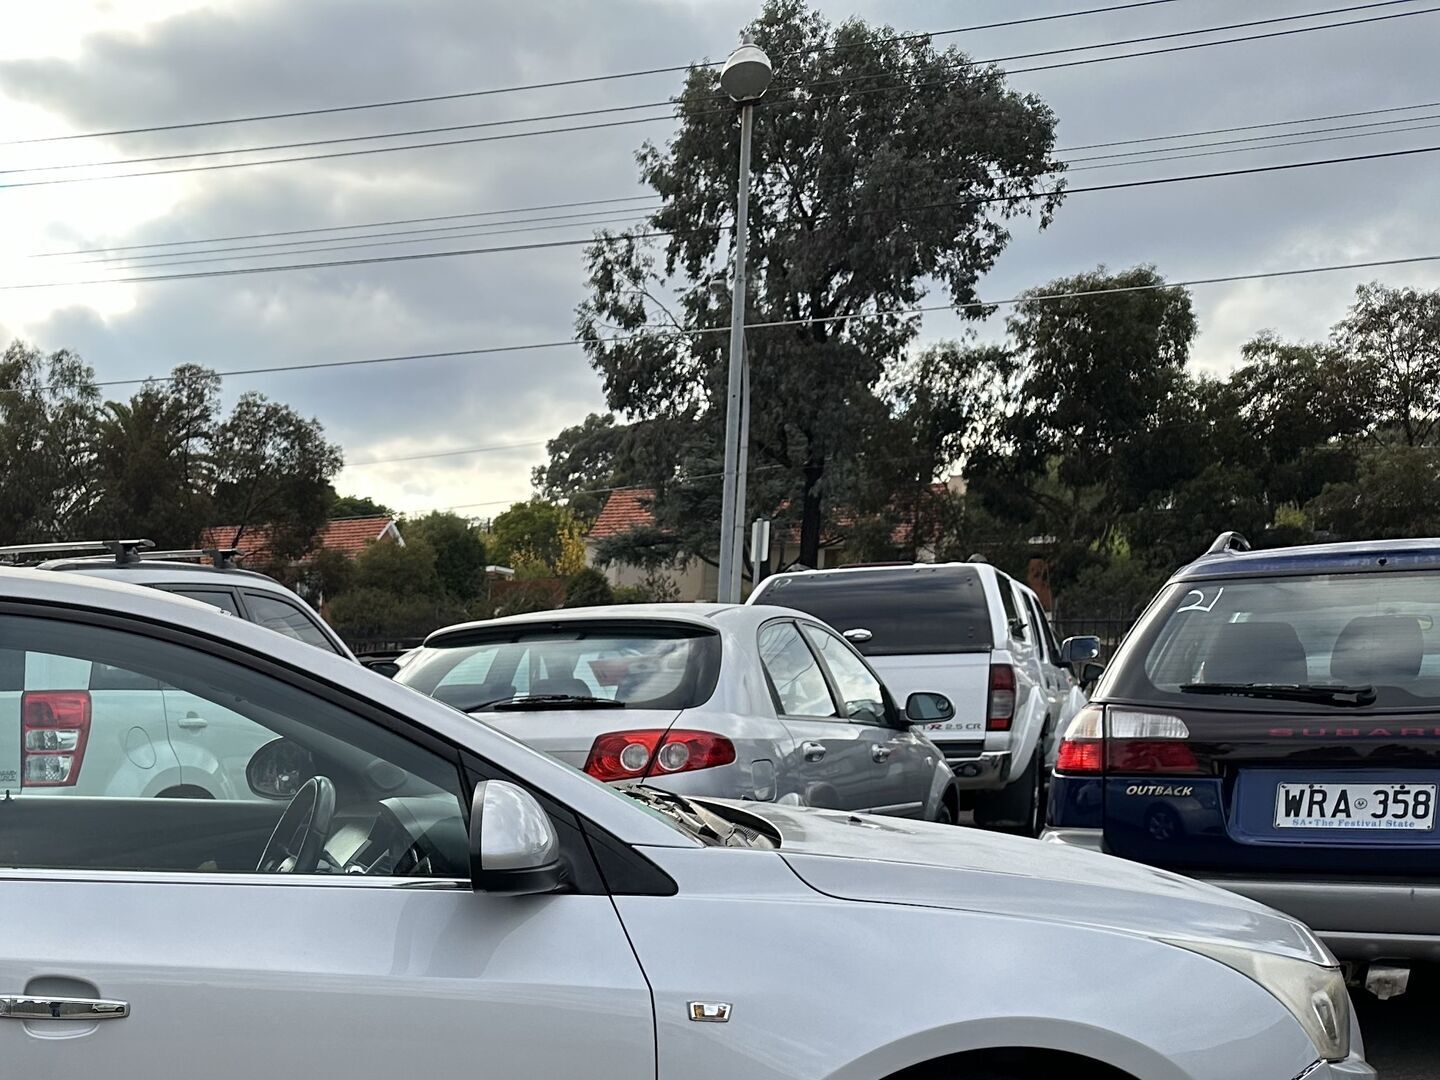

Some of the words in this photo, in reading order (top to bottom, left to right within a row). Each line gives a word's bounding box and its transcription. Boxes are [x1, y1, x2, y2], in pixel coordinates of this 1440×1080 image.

[1266, 728, 1440, 737] SUBAR
[1126, 785, 1193, 796] OUTBACK
[1284, 788, 1353, 818] WRA
[1370, 789, 1432, 820] 358
[1338, 819, 1383, 827] Festival
[1385, 819, 1416, 828] State
